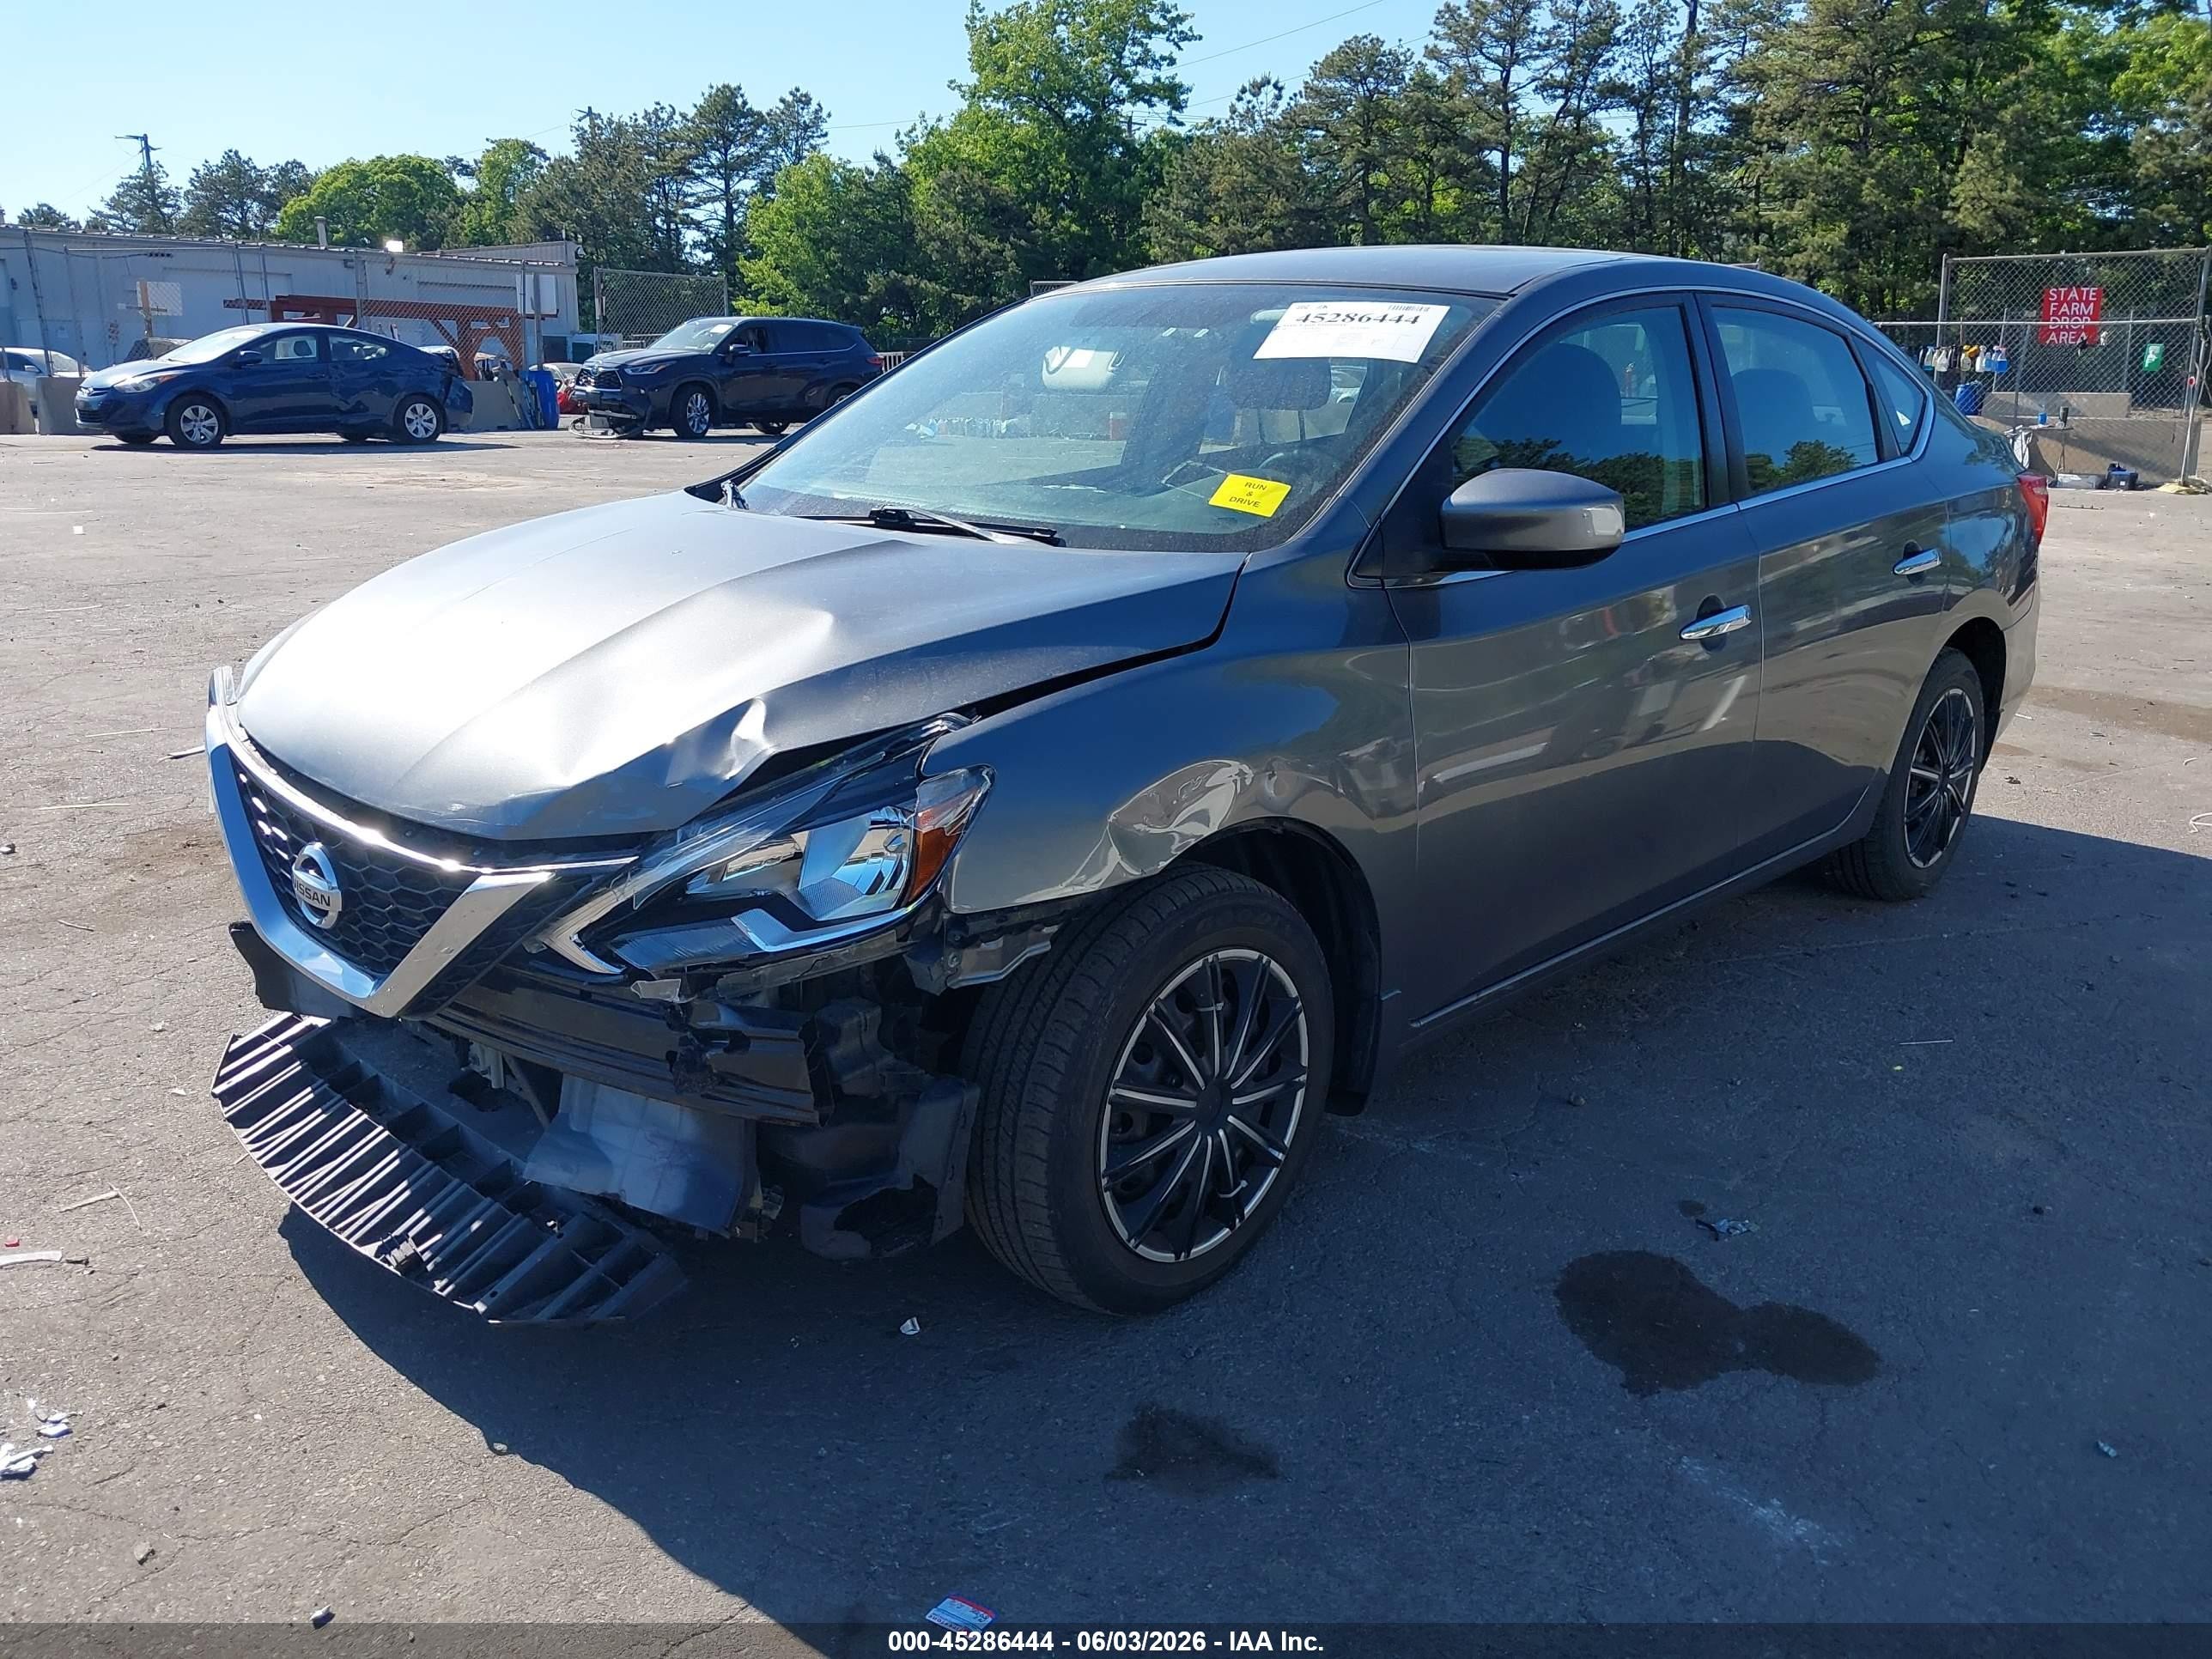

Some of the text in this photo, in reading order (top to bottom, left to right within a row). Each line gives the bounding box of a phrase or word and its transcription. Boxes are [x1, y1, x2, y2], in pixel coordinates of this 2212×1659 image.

[2049, 287, 2098, 301] STATE
[2050, 302, 2094, 315] FARM
[1296, 313, 1420, 324] 45286444
[2049, 317, 2090, 329] DROP
[1229, 496, 1261, 507] DRIVE
[295, 879, 331, 907] NISSAN
